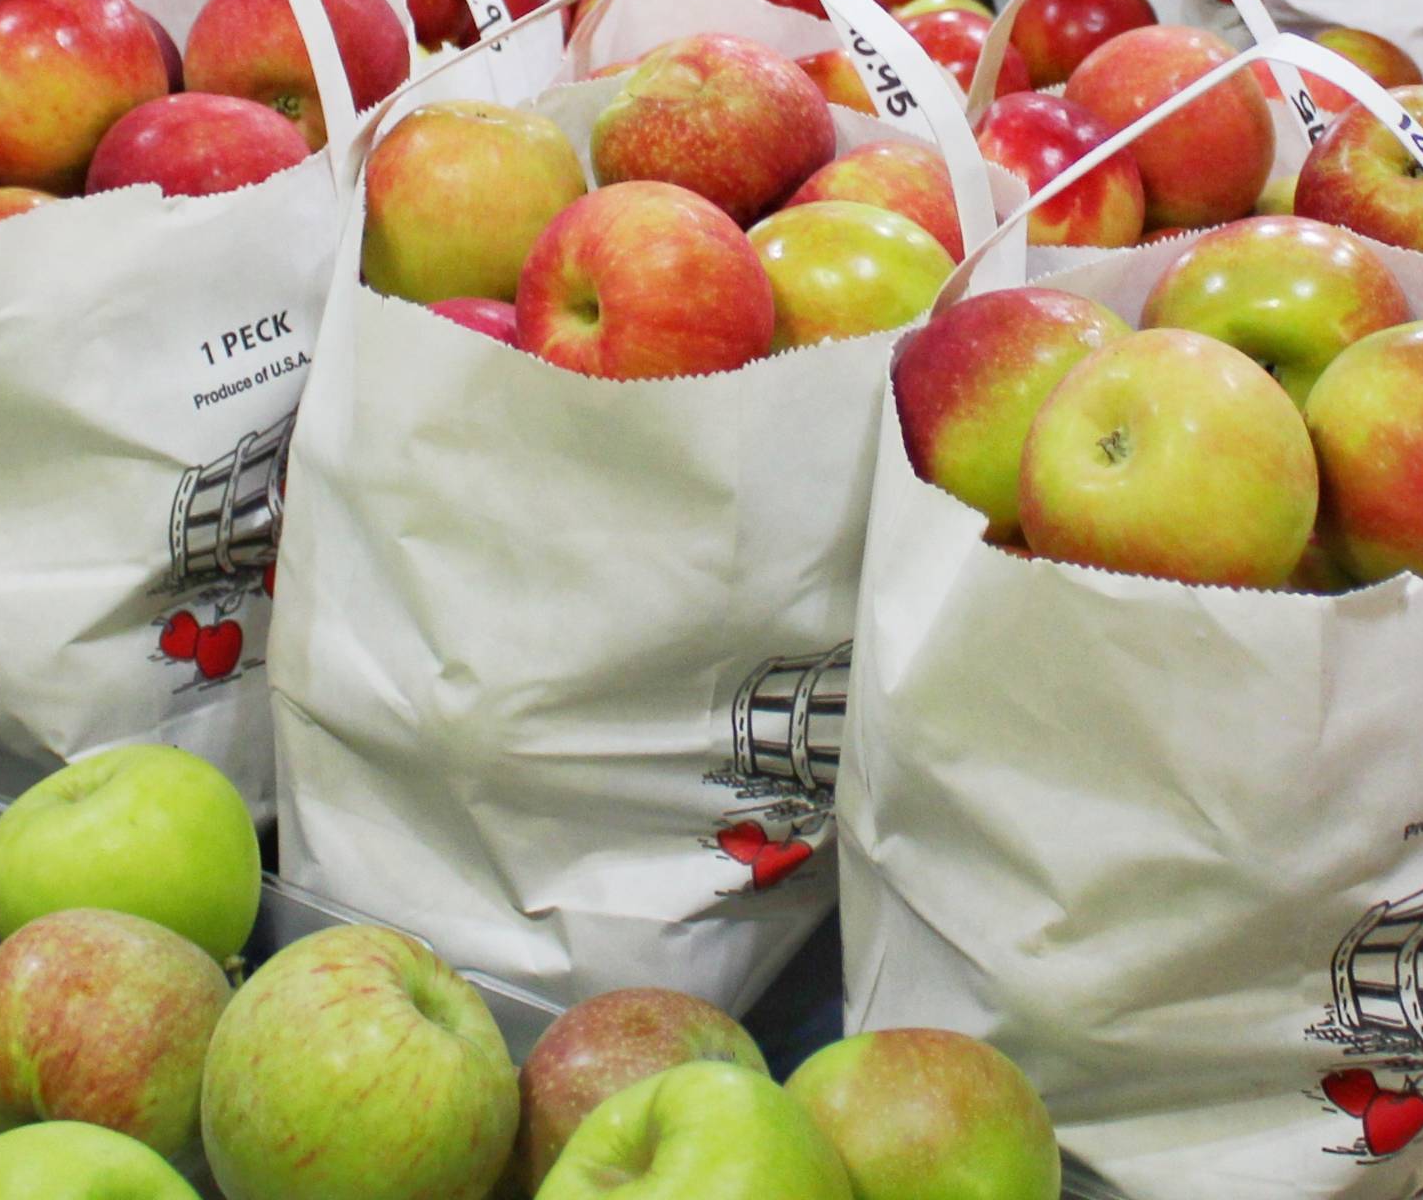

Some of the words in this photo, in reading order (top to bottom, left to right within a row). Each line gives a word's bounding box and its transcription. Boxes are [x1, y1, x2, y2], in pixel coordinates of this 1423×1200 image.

[200, 341, 215, 366] 1
[221, 309, 293, 358] PECK
[193, 376, 253, 411] Produce
[254, 365, 269, 385] of
[269, 351, 313, 379] U.S.A.
